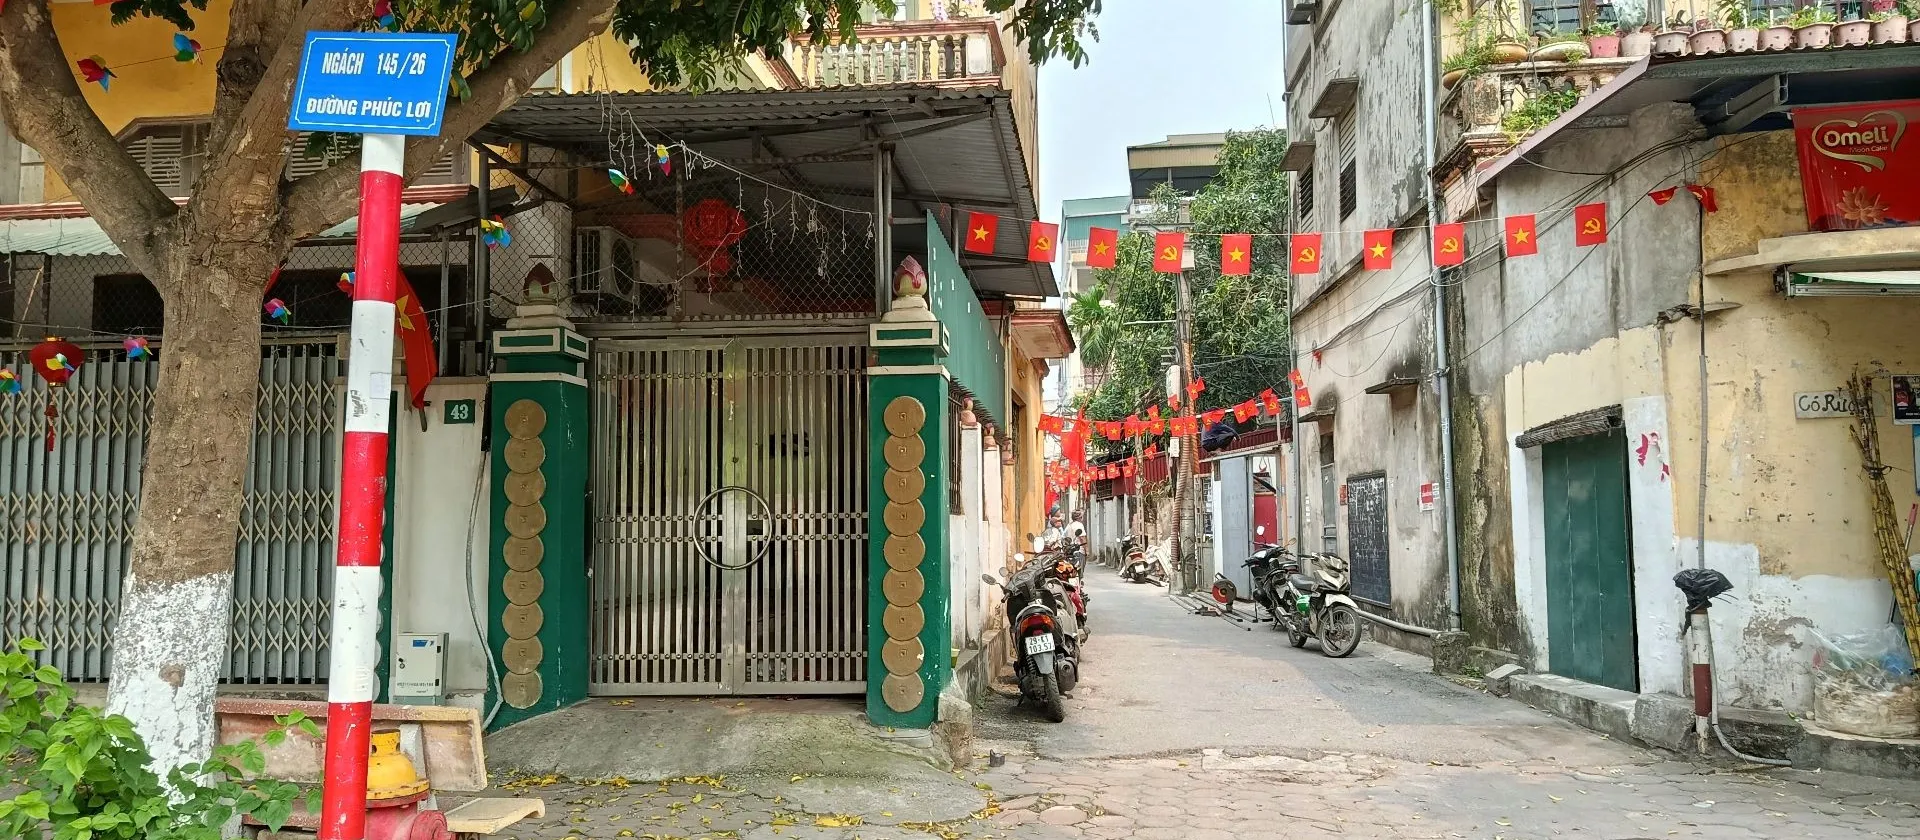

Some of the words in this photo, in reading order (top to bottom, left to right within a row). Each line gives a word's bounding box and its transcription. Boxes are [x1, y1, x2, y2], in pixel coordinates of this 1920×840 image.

[321, 48, 365, 75] NGÁCH
[306, 94, 358, 116] ĐƯỜNG
[360, 97, 402, 117] PHÚC
[405, 100, 431, 123] LỢI
[1823, 126, 1889, 147] Omeli
[450, 403, 469, 420] 43
[1798, 395, 1820, 412] Có
